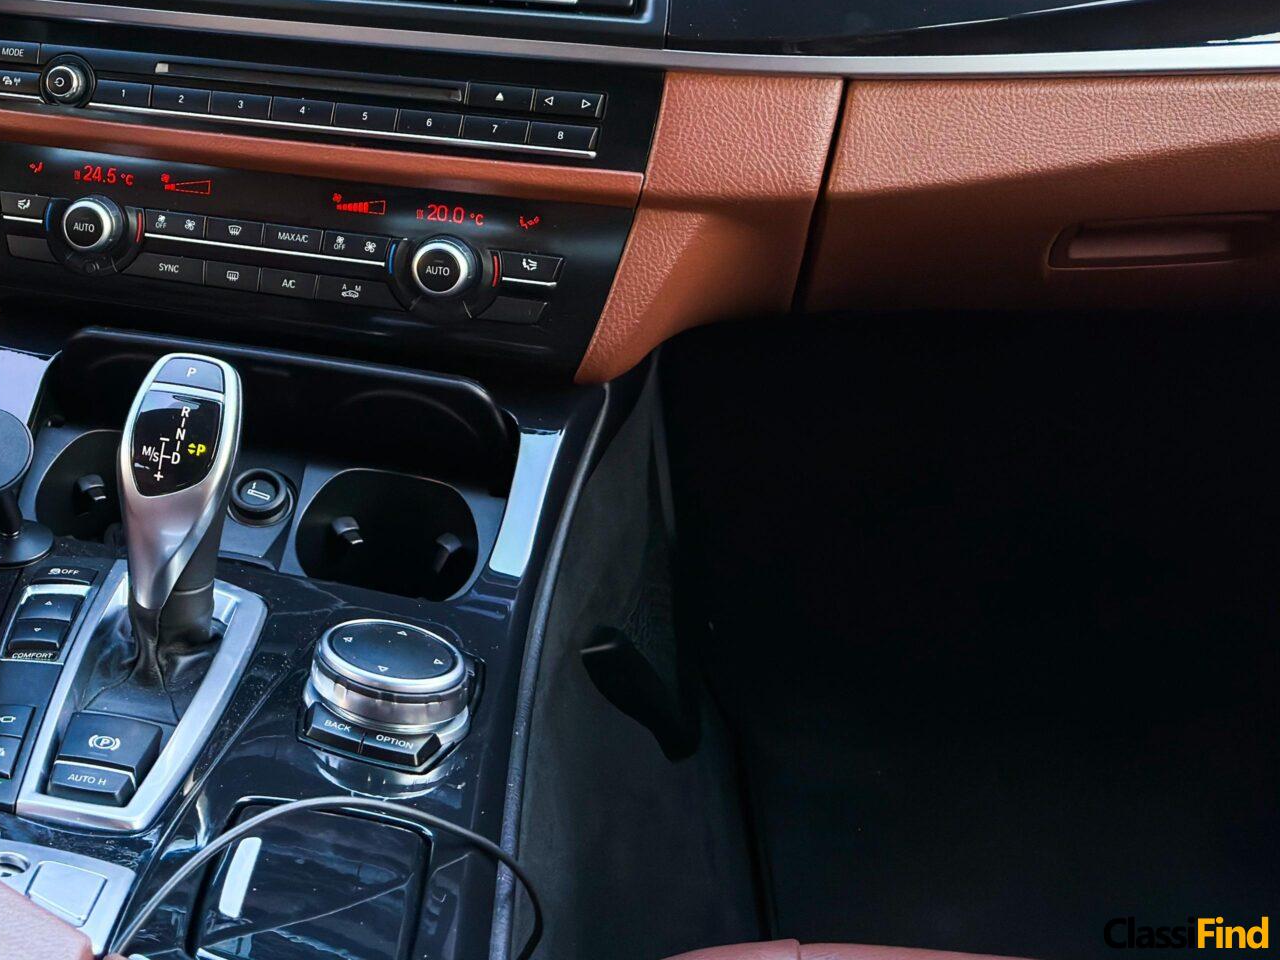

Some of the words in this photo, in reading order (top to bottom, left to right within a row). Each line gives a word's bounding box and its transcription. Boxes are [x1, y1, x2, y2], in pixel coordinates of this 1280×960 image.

[1, 48, 24, 57] MODE
[178, 95, 185, 103] 2
[238, 100, 244, 109] 3
[299, 106, 306, 114] 4
[362, 111, 368, 121] 5
[426, 118, 432, 127] 6
[492, 124, 498, 133] 7
[557, 131, 564, 140] 8
[82, 164, 118, 184] 24.5
[427, 204, 466, 225] 20.0
[73, 222, 95, 233] AUTO
[333, 243, 346, 251] OFF
[158, 262, 179, 273] SYNC
[425, 265, 450, 276] AUTO
[281, 279, 296, 289] A/C
[187, 367, 197, 377] P
[181, 406, 190, 417] R
[176, 428, 186, 440] N
[196, 444, 206, 456] P
[171, 451, 181, 464] D
[324, 719, 352, 732] BACK
[376, 734, 414, 749] OPTION
[68, 773, 96, 784] AUTO
[98, 778, 107, 786] H
